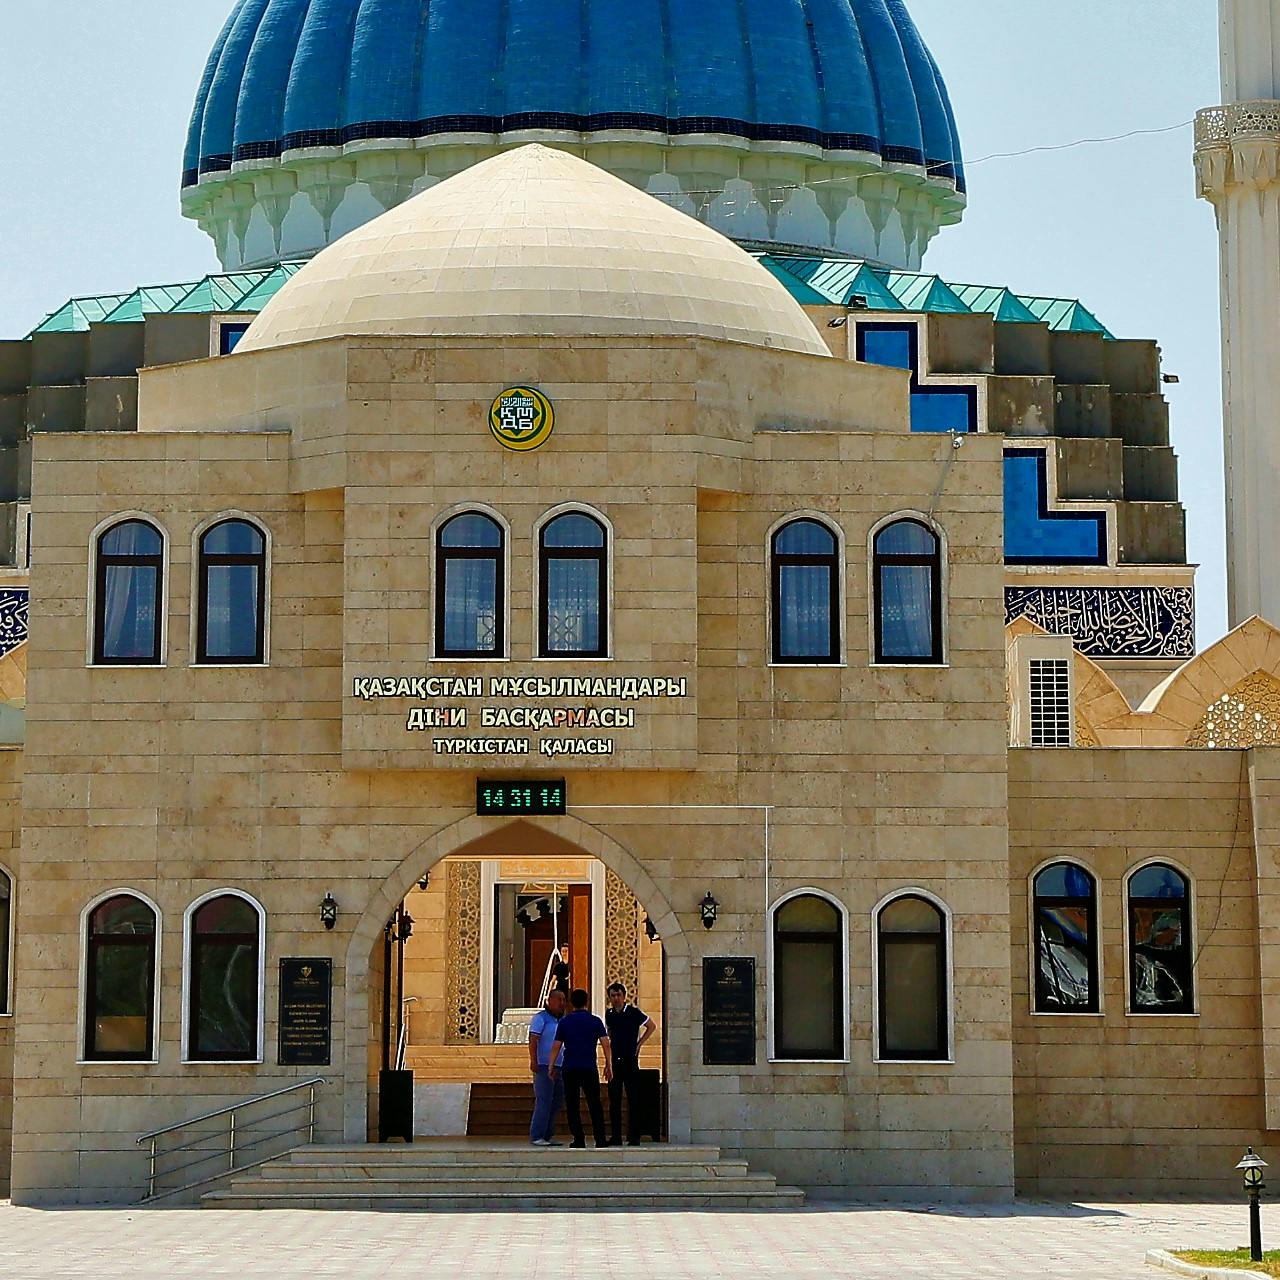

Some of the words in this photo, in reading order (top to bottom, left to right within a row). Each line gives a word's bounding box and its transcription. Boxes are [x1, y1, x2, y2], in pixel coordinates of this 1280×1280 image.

[353, 677, 483, 700] ҚАЗАҚСТАН
[490, 677, 687, 700] МҰСЫЛМАНДАРЫ
[406, 708, 466, 731] ДІНИ
[481, 707, 634, 731] БАСҚАРМАСЫ
[433, 738, 529, 754] ТҮРКІСТАН
[539, 738, 613, 756] ҚАЛАСЫ
[483, 789, 504, 806] 14
[510, 789, 531, 806] 31
[540, 789, 561, 806] 14
